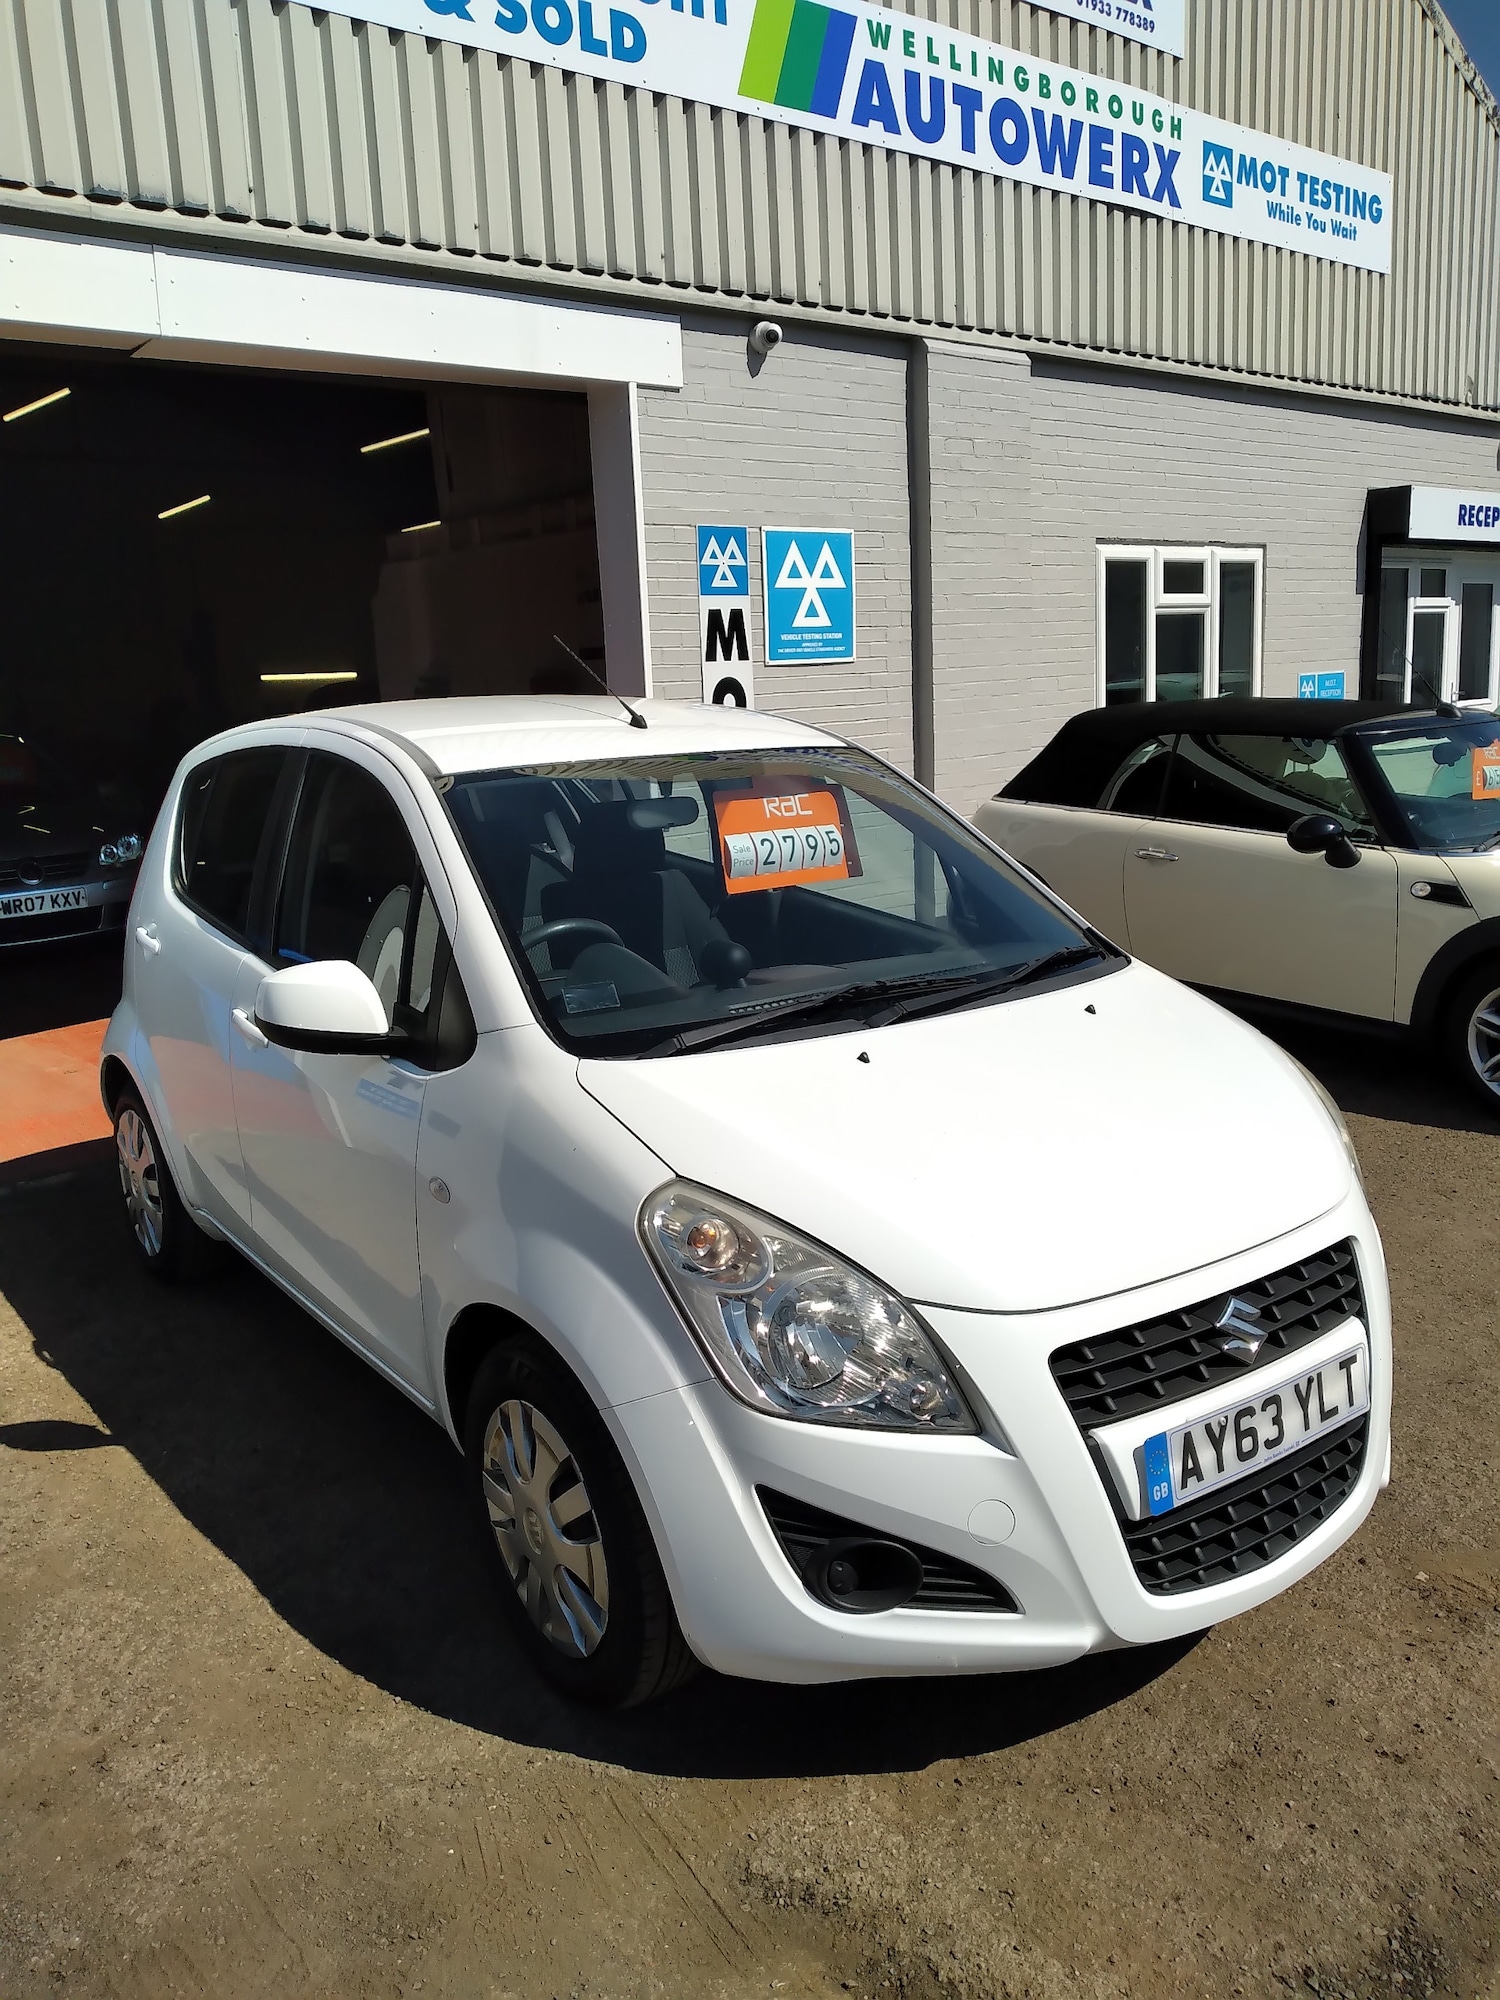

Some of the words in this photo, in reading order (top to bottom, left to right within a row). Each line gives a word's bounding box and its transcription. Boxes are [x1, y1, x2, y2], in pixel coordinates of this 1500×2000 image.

[495, 0, 647, 63] SOLD
[1115, 6, 1155, 33] 778389
[867, 19, 1182, 140] WELLINGBOROUGH
[851, 58, 1182, 209] AUTOWERX
[1237, 153, 1290, 197] MOT
[1297, 171, 1383, 224] TESTING
[1266, 200, 1302, 226] While
[1305, 212, 1326, 233] You
[1331, 219, 1358, 241] Wait
[1458, 504, 1500, 527] RECEP
[780, 633, 802, 641] VEHICLE
[733, 844, 751, 853] Sale
[733, 856, 754, 867] Price
[760, 830, 840, 866] 2795
[1, 895, 45, 915] WR07
[50, 891, 81, 909] KXV
[1180, 1393, 1284, 1490] AY63
[1294, 1354, 1358, 1432] YLT
[1153, 1482, 1169, 1501] GB
